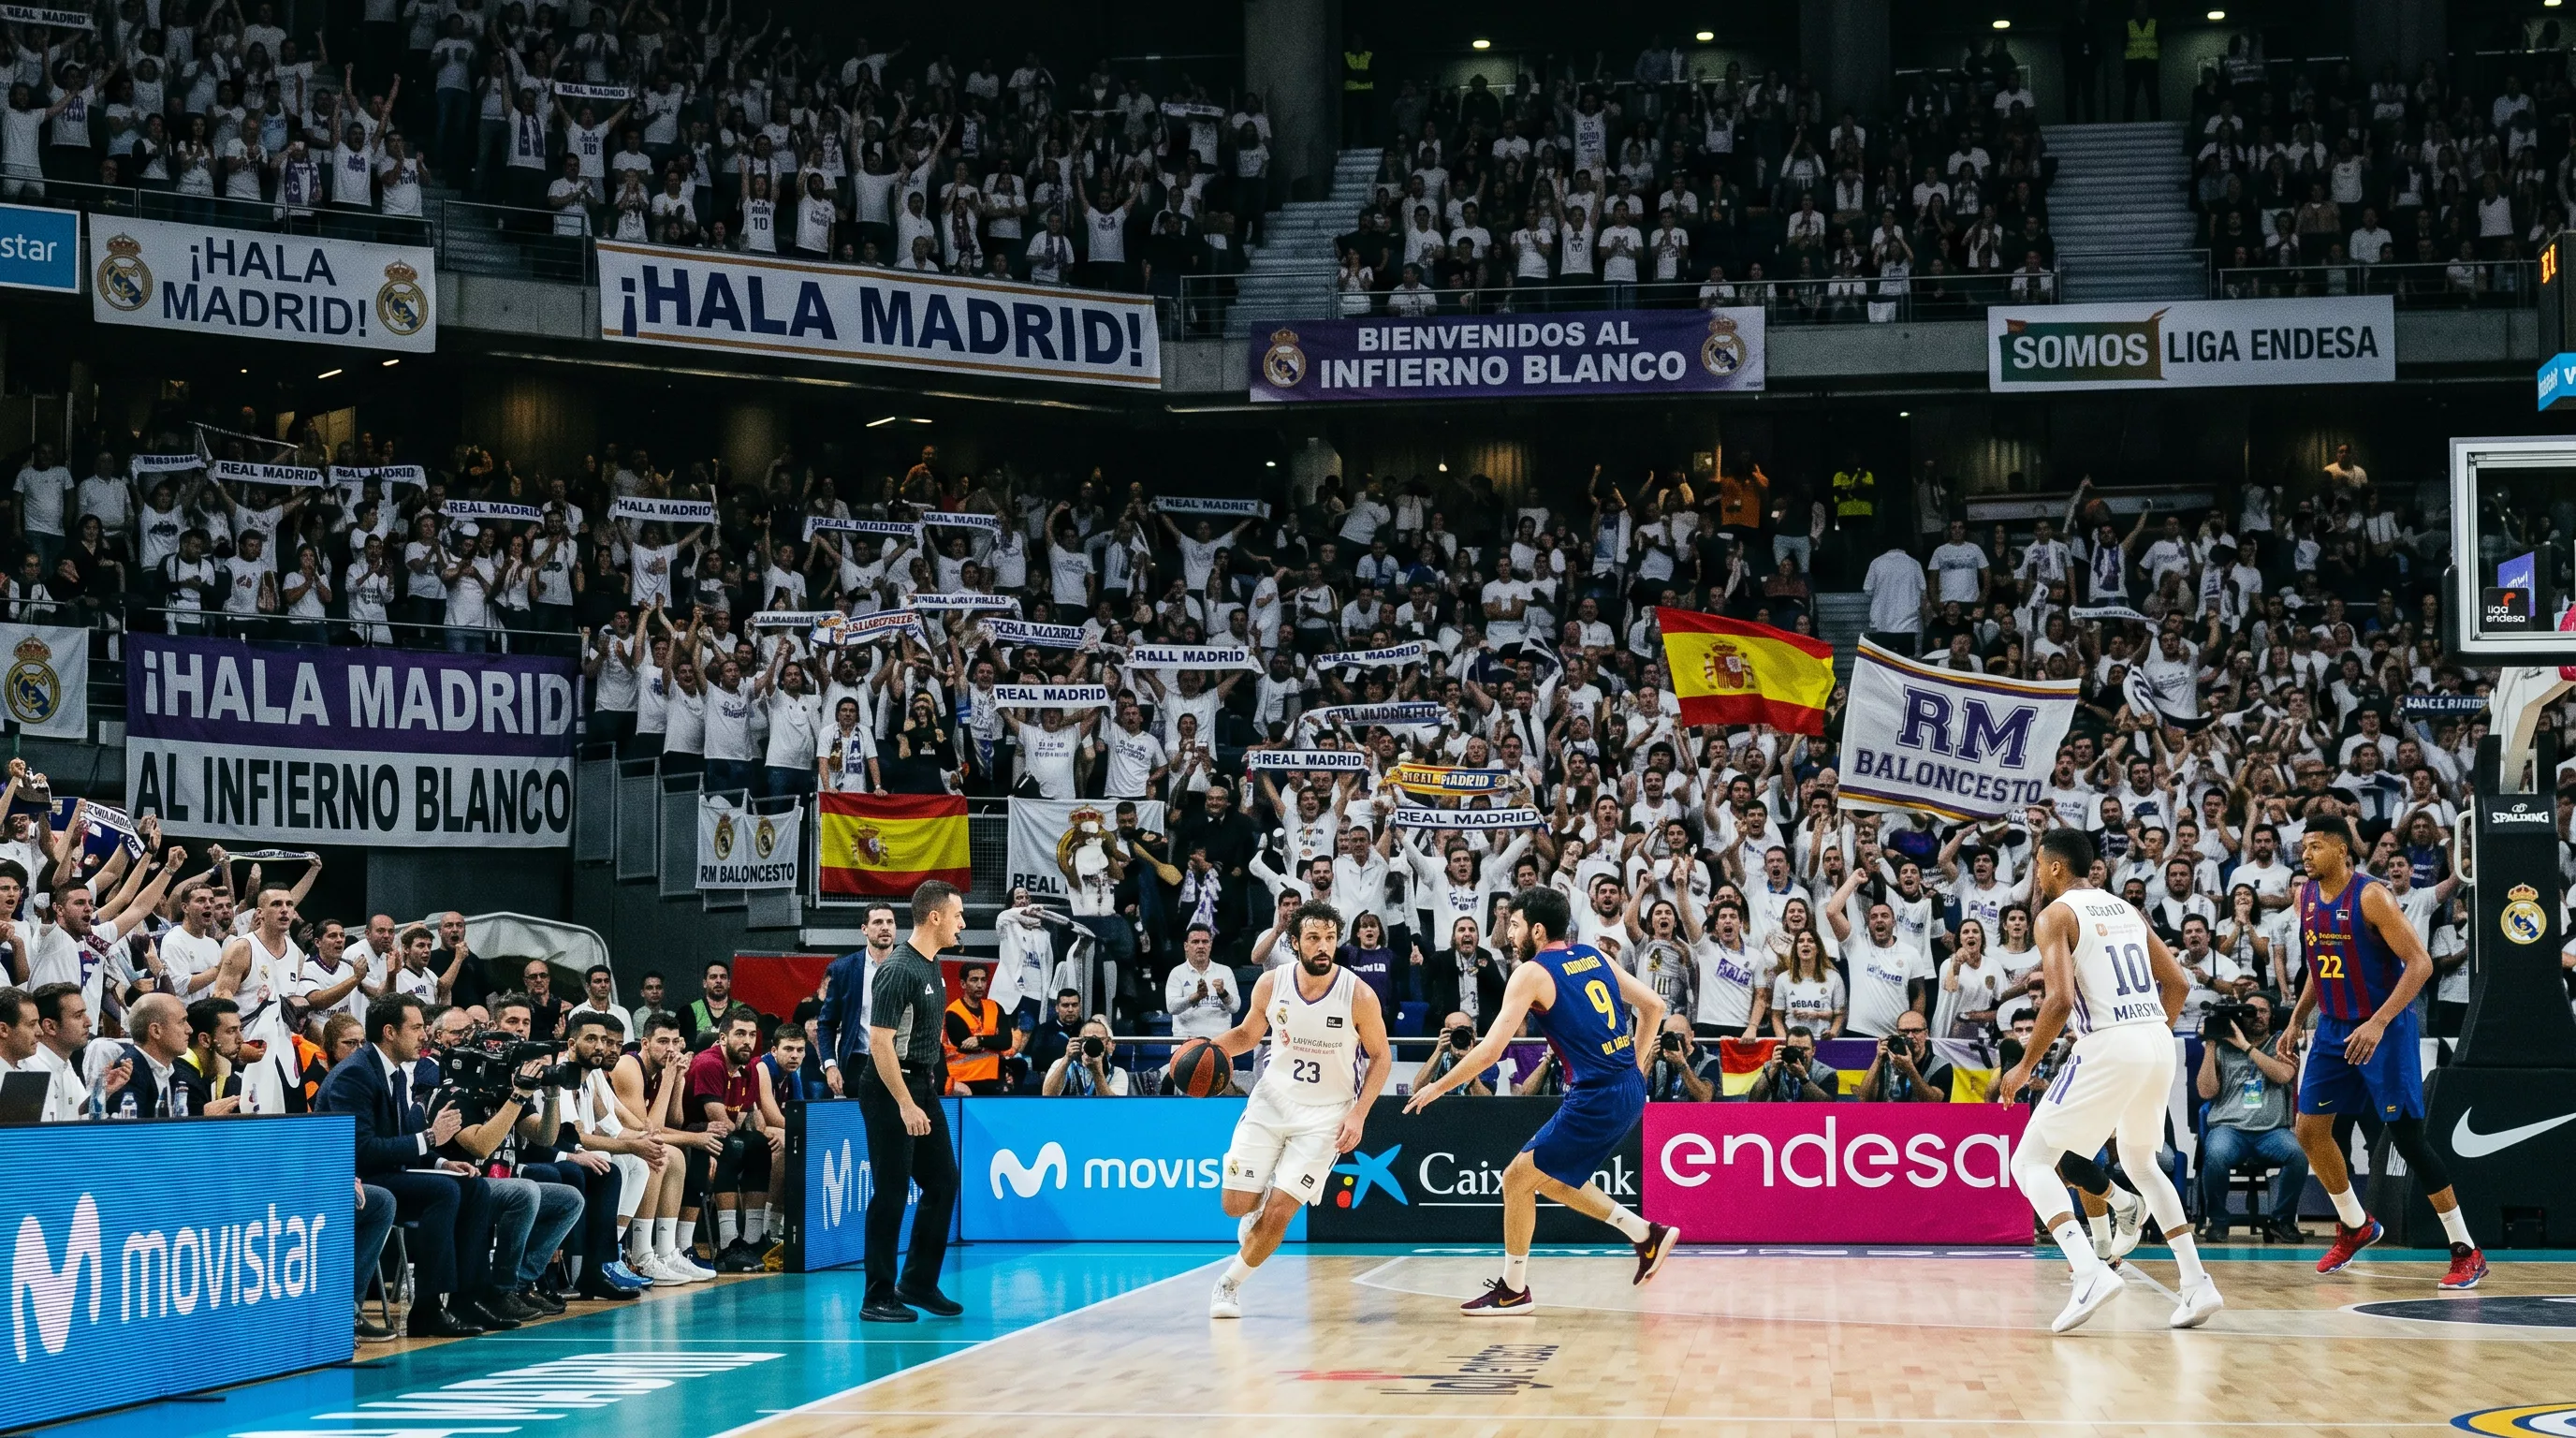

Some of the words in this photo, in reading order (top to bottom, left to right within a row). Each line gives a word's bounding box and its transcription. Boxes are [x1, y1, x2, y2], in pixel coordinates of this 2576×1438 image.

[190, 237, 336, 286] ¡HALA
[162, 281, 367, 337] MADRID!
[622, 265, 838, 337] ¡HALA
[859, 287, 1143, 367] MADRID!
[1358, 324, 1585, 351] BIENVENIDOS
[1596, 321, 1639, 345] AL
[2012, 333, 2148, 369] SOMOS
[2168, 330, 2240, 363] LIGA
[2250, 326, 2378, 361] ENDESA
[1321, 357, 1509, 389] INFIERNO
[1523, 351, 1686, 384] BLANCO
[221, 462, 257, 477] REAL
[263, 466, 318, 481] MADRID
[449, 502, 486, 514] REAL
[489, 504, 543, 518] MADRID
[618, 499, 655, 513] HALA
[659, 504, 710, 516] MADRID
[2486, 614, 2525, 623] endesa
[2487, 605, 2509, 615] liga
[1182, 651, 1245, 662] MADRID
[1365, 645, 1421, 660] MADRID
[144, 650, 330, 726] ¡HALA
[996, 688, 1038, 700] REAL
[1044, 688, 1105, 700] MADRID
[1895, 684, 2038, 770] RM
[1262, 754, 1300, 765] REAL
[1305, 755, 1362, 766] MADRID
[1853, 747, 2042, 804] BALONCESTO
[134, 752, 188, 821] AL
[203, 756, 400, 831] INFIERNO
[416, 766, 571, 835] BLANCO
[1398, 811, 1447, 824] REAL
[1455, 811, 1537, 824] MADRID
[2492, 812, 2549, 824] SPALDING
[700, 865, 717, 883] RM
[720, 862, 795, 883] BALONCESTO
[2105, 943, 2151, 996] 10
[2318, 955, 2345, 978] 22
[1585, 979, 1616, 1029] 9
[1294, 1059, 1321, 1083] 23
[1661, 1115, 2012, 1188] endesa
[1084, 1158, 1219, 1189] movis
[121, 1203, 326, 1324] movistar
